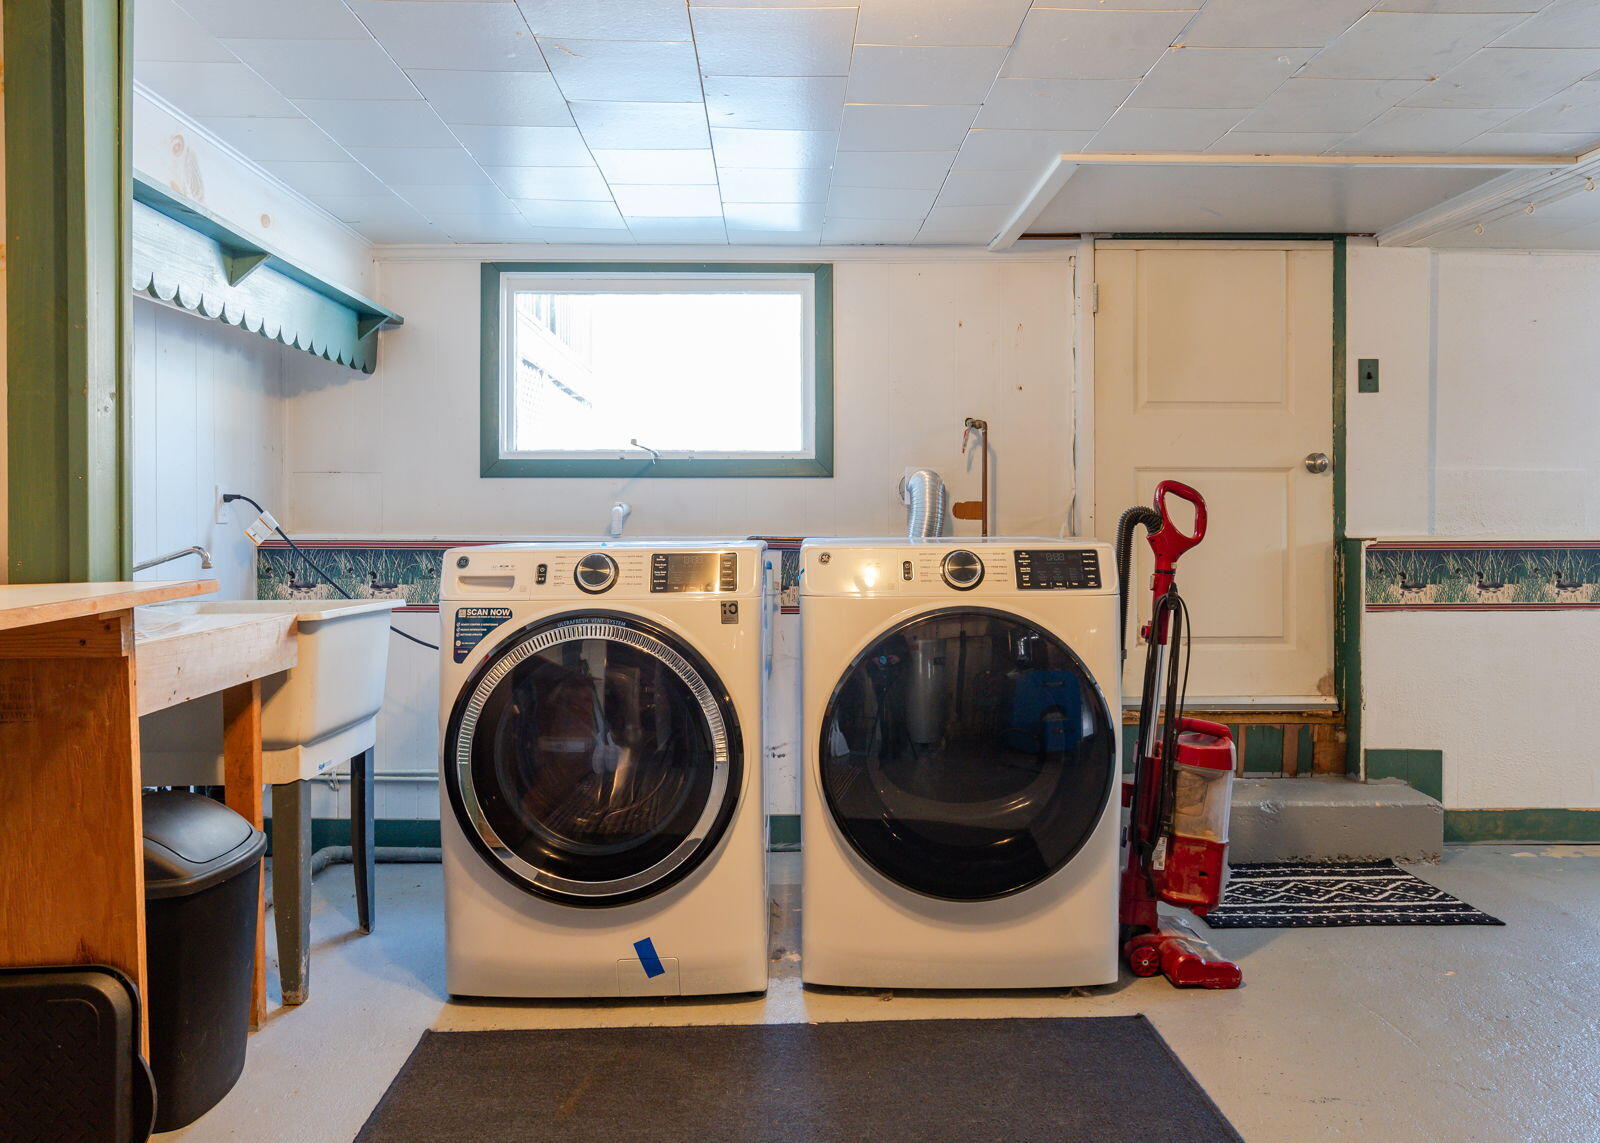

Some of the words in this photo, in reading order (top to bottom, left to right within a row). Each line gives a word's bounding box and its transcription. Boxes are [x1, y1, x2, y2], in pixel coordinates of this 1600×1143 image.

[466, 608, 488, 616] SCAN
[490, 608, 511, 616] NOW
[606, 618, 626, 627] SYSTEM
